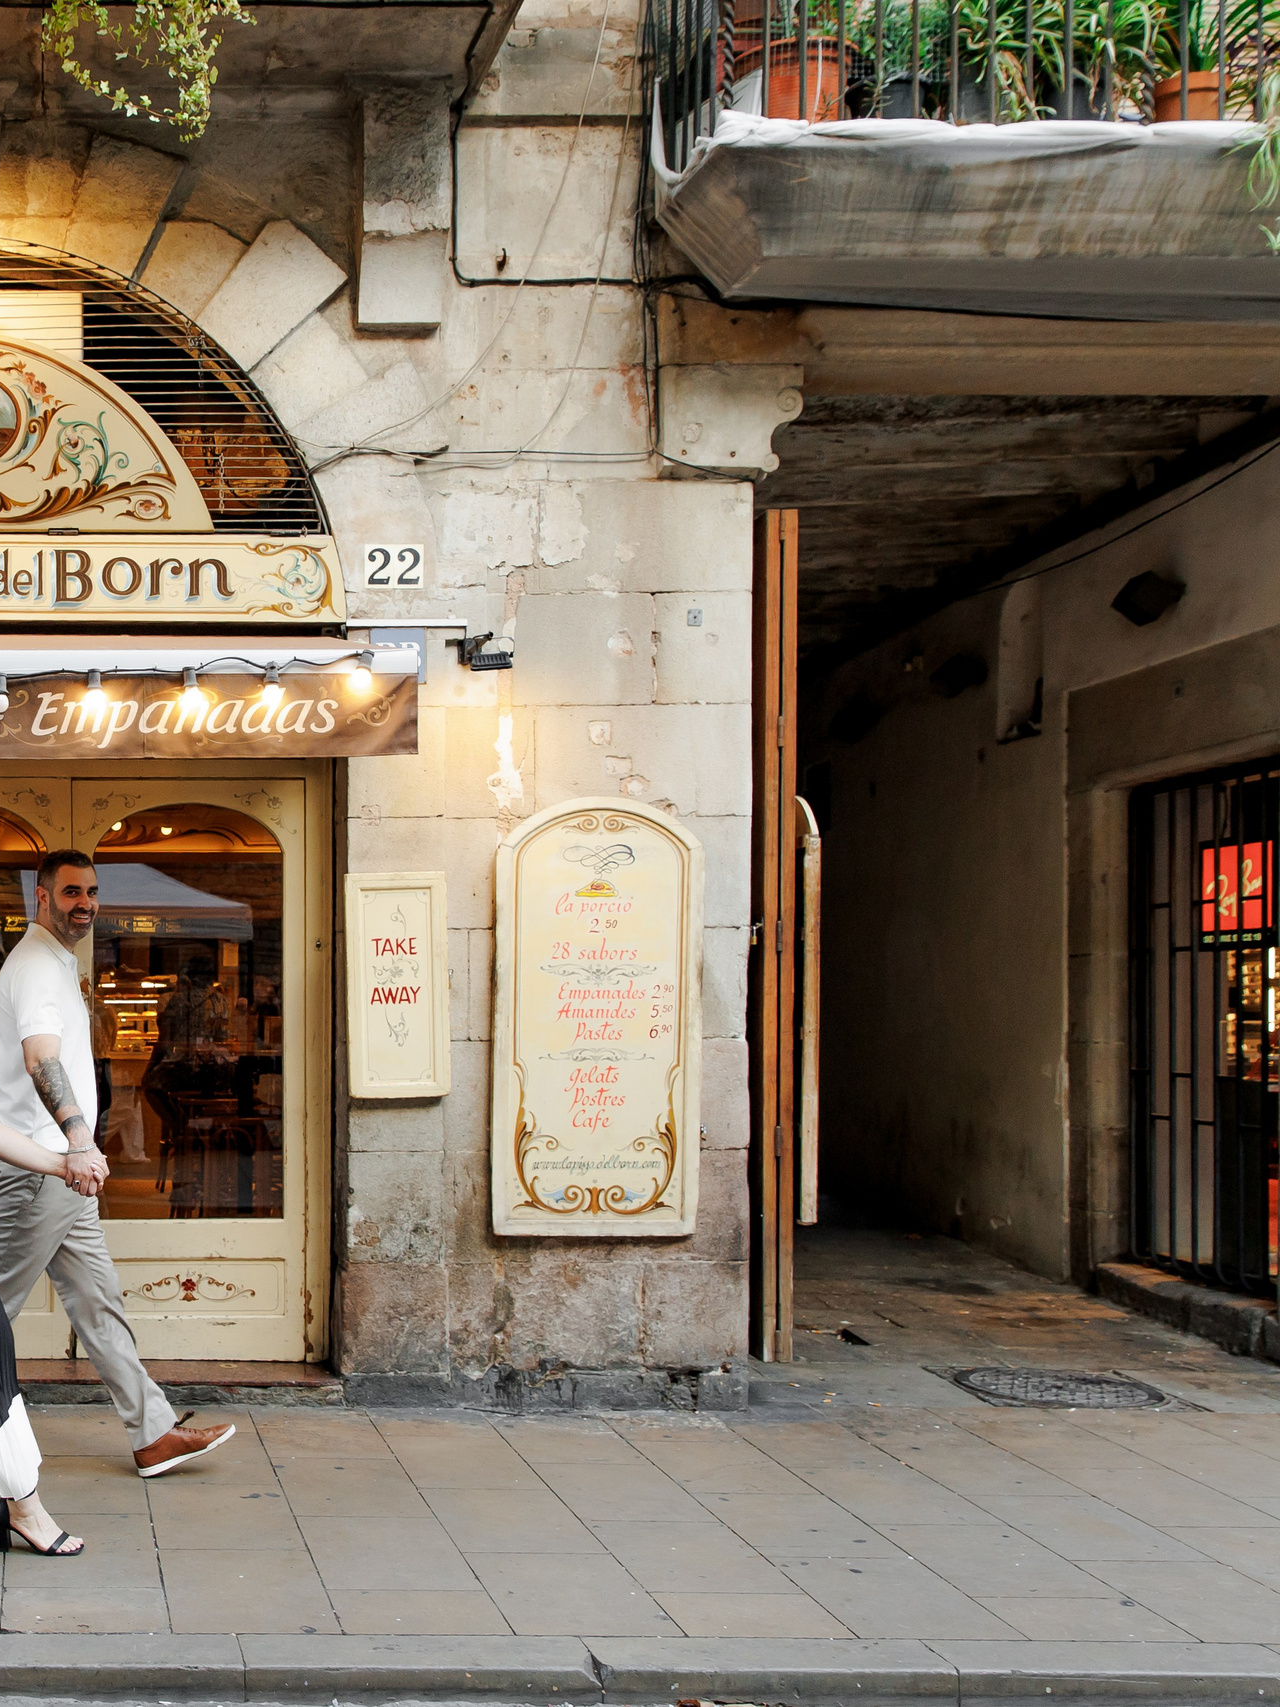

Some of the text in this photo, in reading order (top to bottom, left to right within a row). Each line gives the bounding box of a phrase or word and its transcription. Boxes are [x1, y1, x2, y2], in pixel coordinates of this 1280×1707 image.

[51, 548, 236, 609] Born
[367, 547, 421, 585] 22
[30, 686, 340, 750] Empanadas
[371, 937, 418, 957] TAKE
[551, 937, 638, 961] 28 sabors
[370, 986, 421, 1006] AWAY
[557, 979, 647, 1005] Empanades
[555, 1000, 638, 1023] Amanides
[572, 1021, 624, 1046] Pastes
[568, 1087, 626, 1114] Postres
[572, 1109, 614, 1135] Cafe
